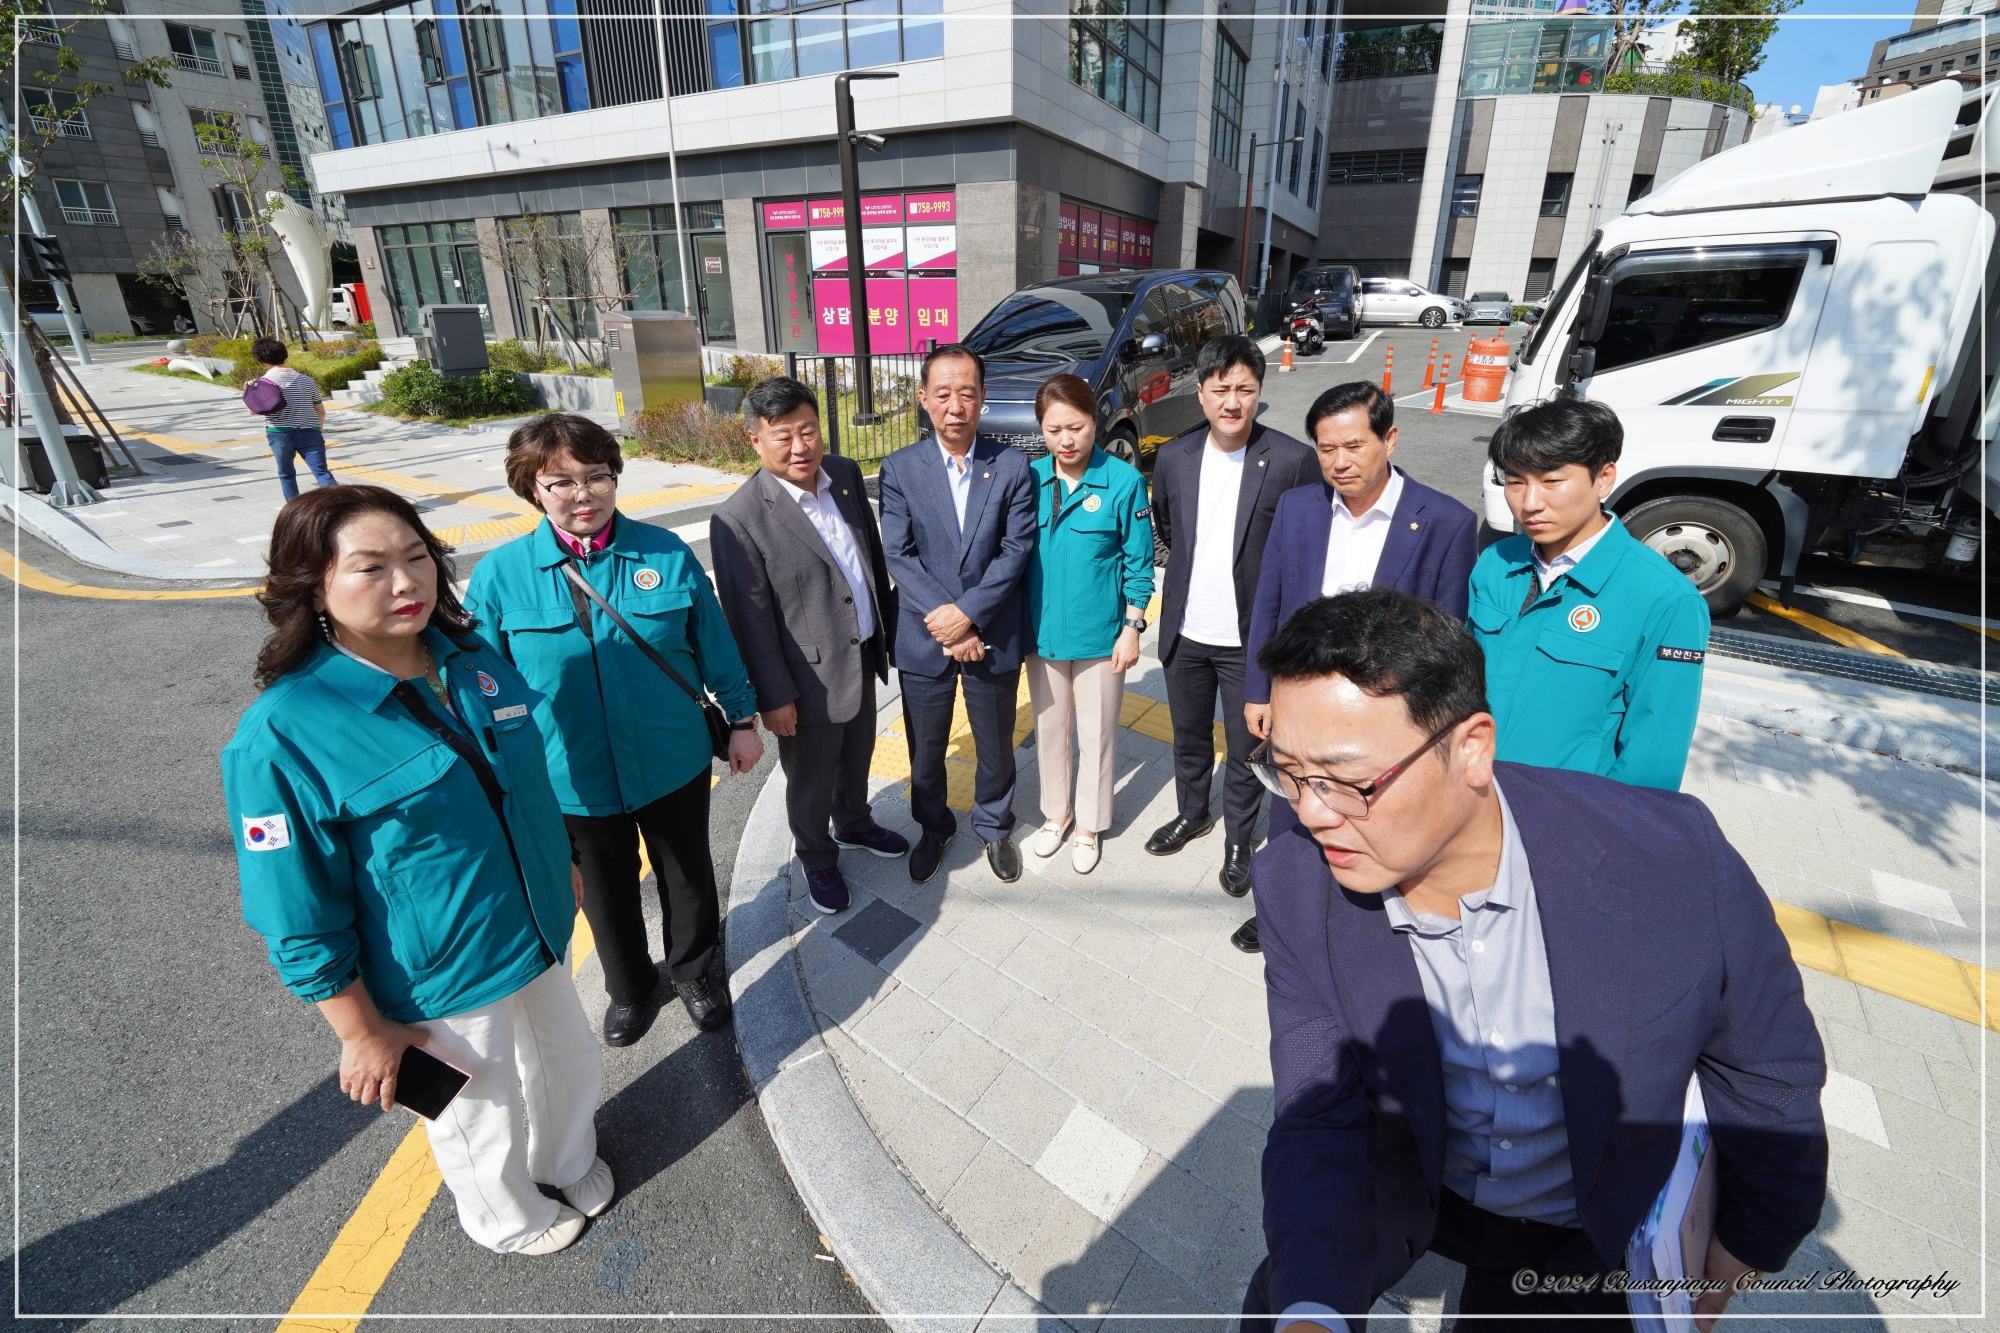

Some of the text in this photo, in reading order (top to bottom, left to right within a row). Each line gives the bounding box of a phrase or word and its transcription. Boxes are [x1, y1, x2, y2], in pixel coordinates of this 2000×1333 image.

[819, 207, 844, 218] 758-999
[917, 201, 951, 213] 758-9993
[785, 253, 801, 338] 분양홍보관
[822, 307, 851, 325] 상담
[868, 307, 899, 326] 분양
[917, 308, 948, 327] 임대
[826, 360, 836, 420] LOTTE CASTLE
[1662, 648, 1703, 661] 부산진구
